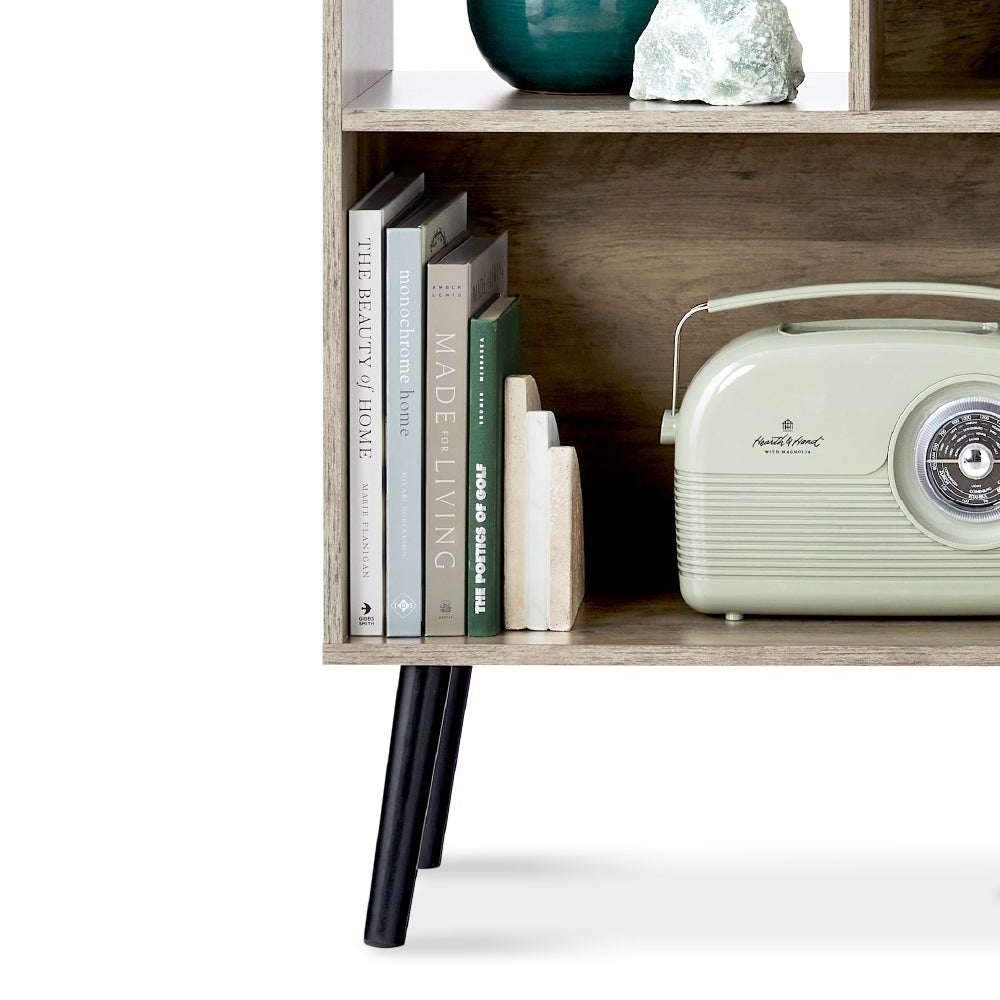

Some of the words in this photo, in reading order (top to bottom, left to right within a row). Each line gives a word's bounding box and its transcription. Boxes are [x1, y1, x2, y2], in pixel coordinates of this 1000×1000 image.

[358, 238, 371, 280] THE
[358, 288, 372, 368] BEAUTY
[400, 270, 416, 384] monochrome
[357, 374, 374, 393] of
[435, 333, 457, 424] MADE
[359, 400, 372, 459] HOME
[400, 390, 415, 438] home
[440, 431, 449, 452] FOR
[752, 434, 786, 448] Hearth
[792, 436, 824, 448] Hand
[476, 463, 487, 500] GOLF
[434, 460, 456, 569] LIVING
[476, 502, 487, 523] OF
[475, 526, 487, 584] POETICS
[474, 587, 486, 615] THE
